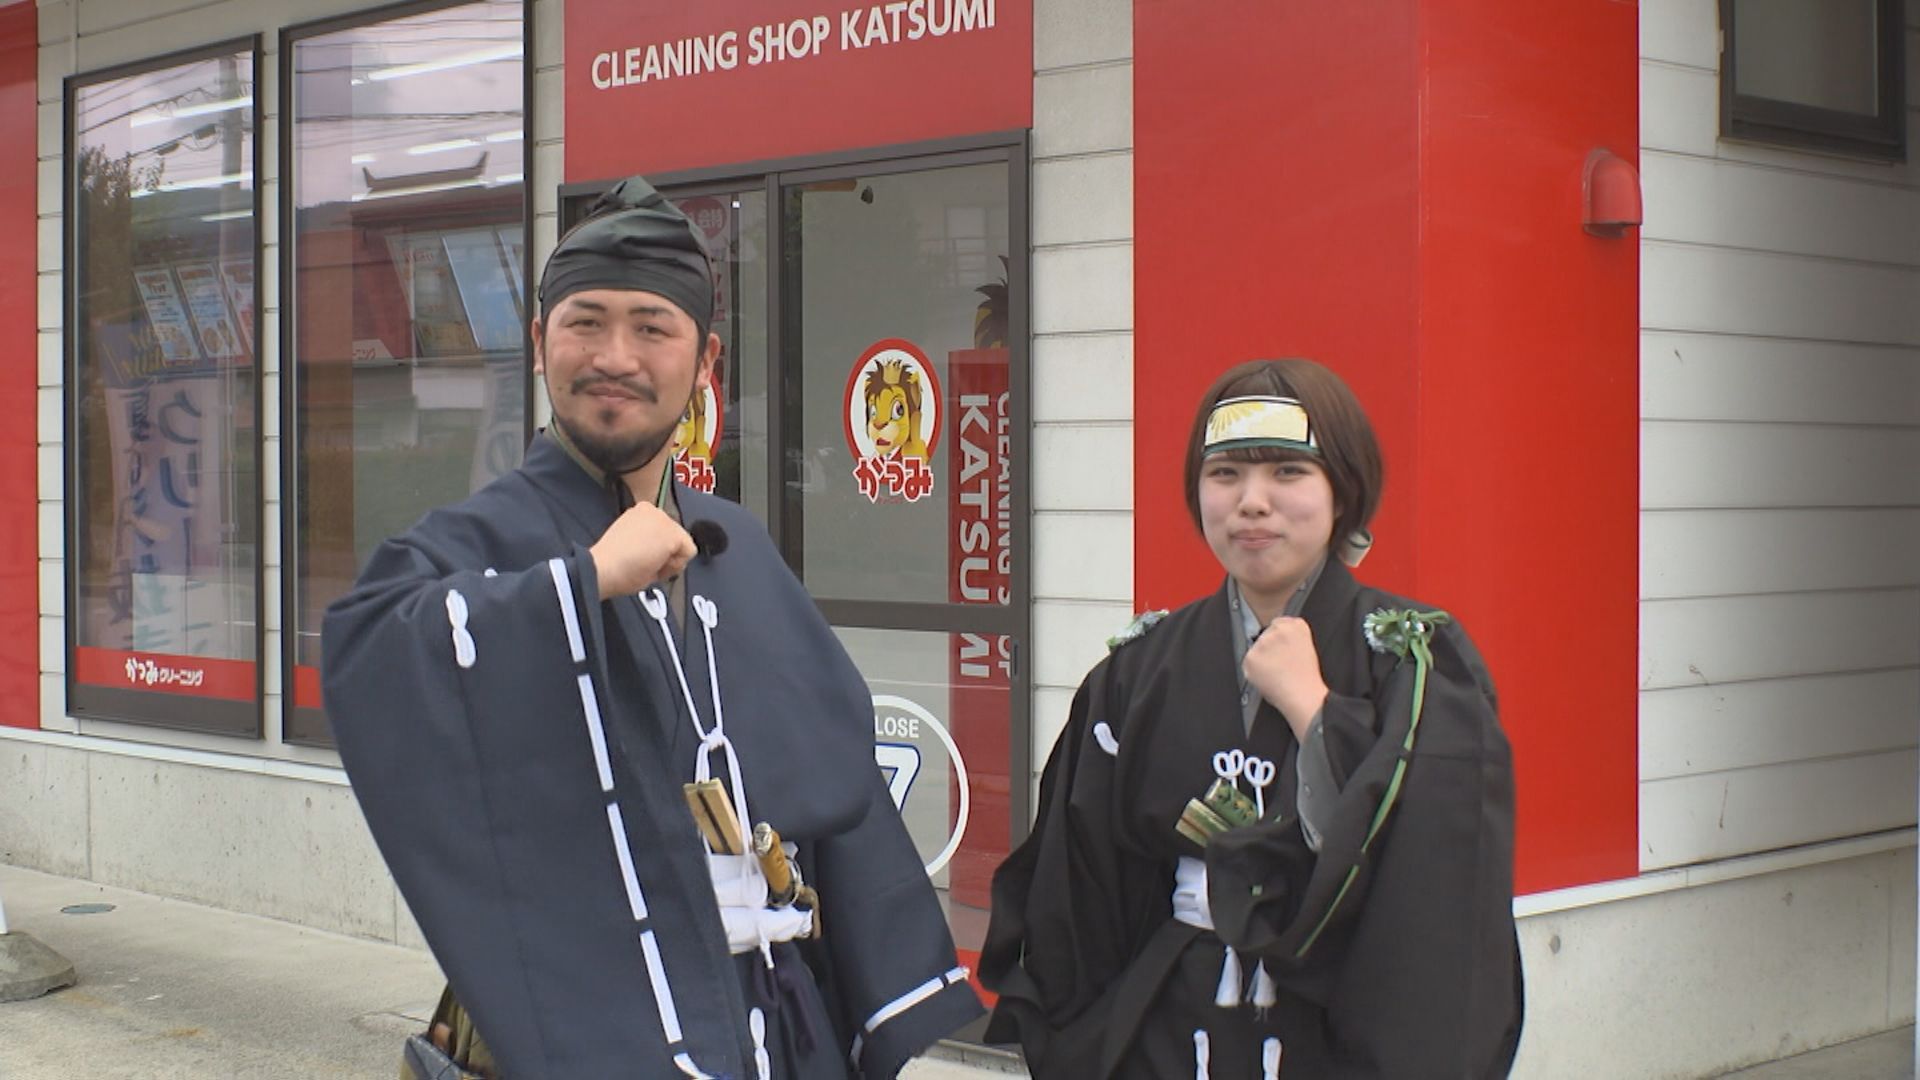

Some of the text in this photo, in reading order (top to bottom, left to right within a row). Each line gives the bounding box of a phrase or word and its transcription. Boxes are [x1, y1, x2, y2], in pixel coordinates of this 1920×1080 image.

[591, 0, 996, 90] CLEANING SHOP KATSUMI
[674, 456, 717, 494] つみ
[853, 456, 934, 503] かつみ
[874, 715, 920, 738] LOSE
